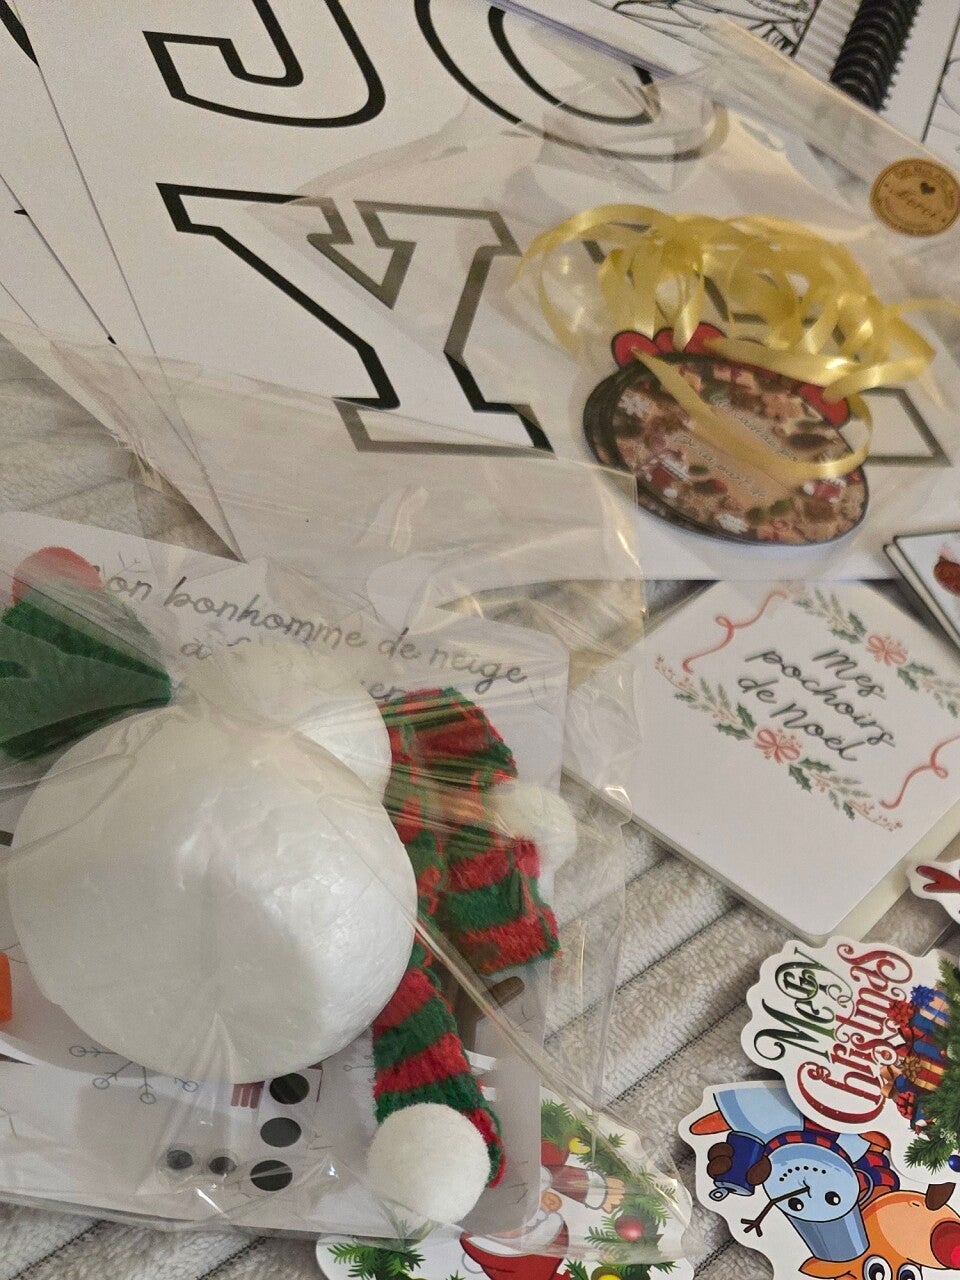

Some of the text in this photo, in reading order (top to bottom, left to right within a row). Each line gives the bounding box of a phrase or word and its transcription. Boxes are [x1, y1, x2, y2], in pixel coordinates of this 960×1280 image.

[163, 576, 367, 650] bonhomme
[376, 627, 419, 661] de
[429, 647, 528, 694] neige
[737, 677, 779, 705] de
[753, 946, 853, 1062] Merry
[796, 943, 914, 1124] Christmas
